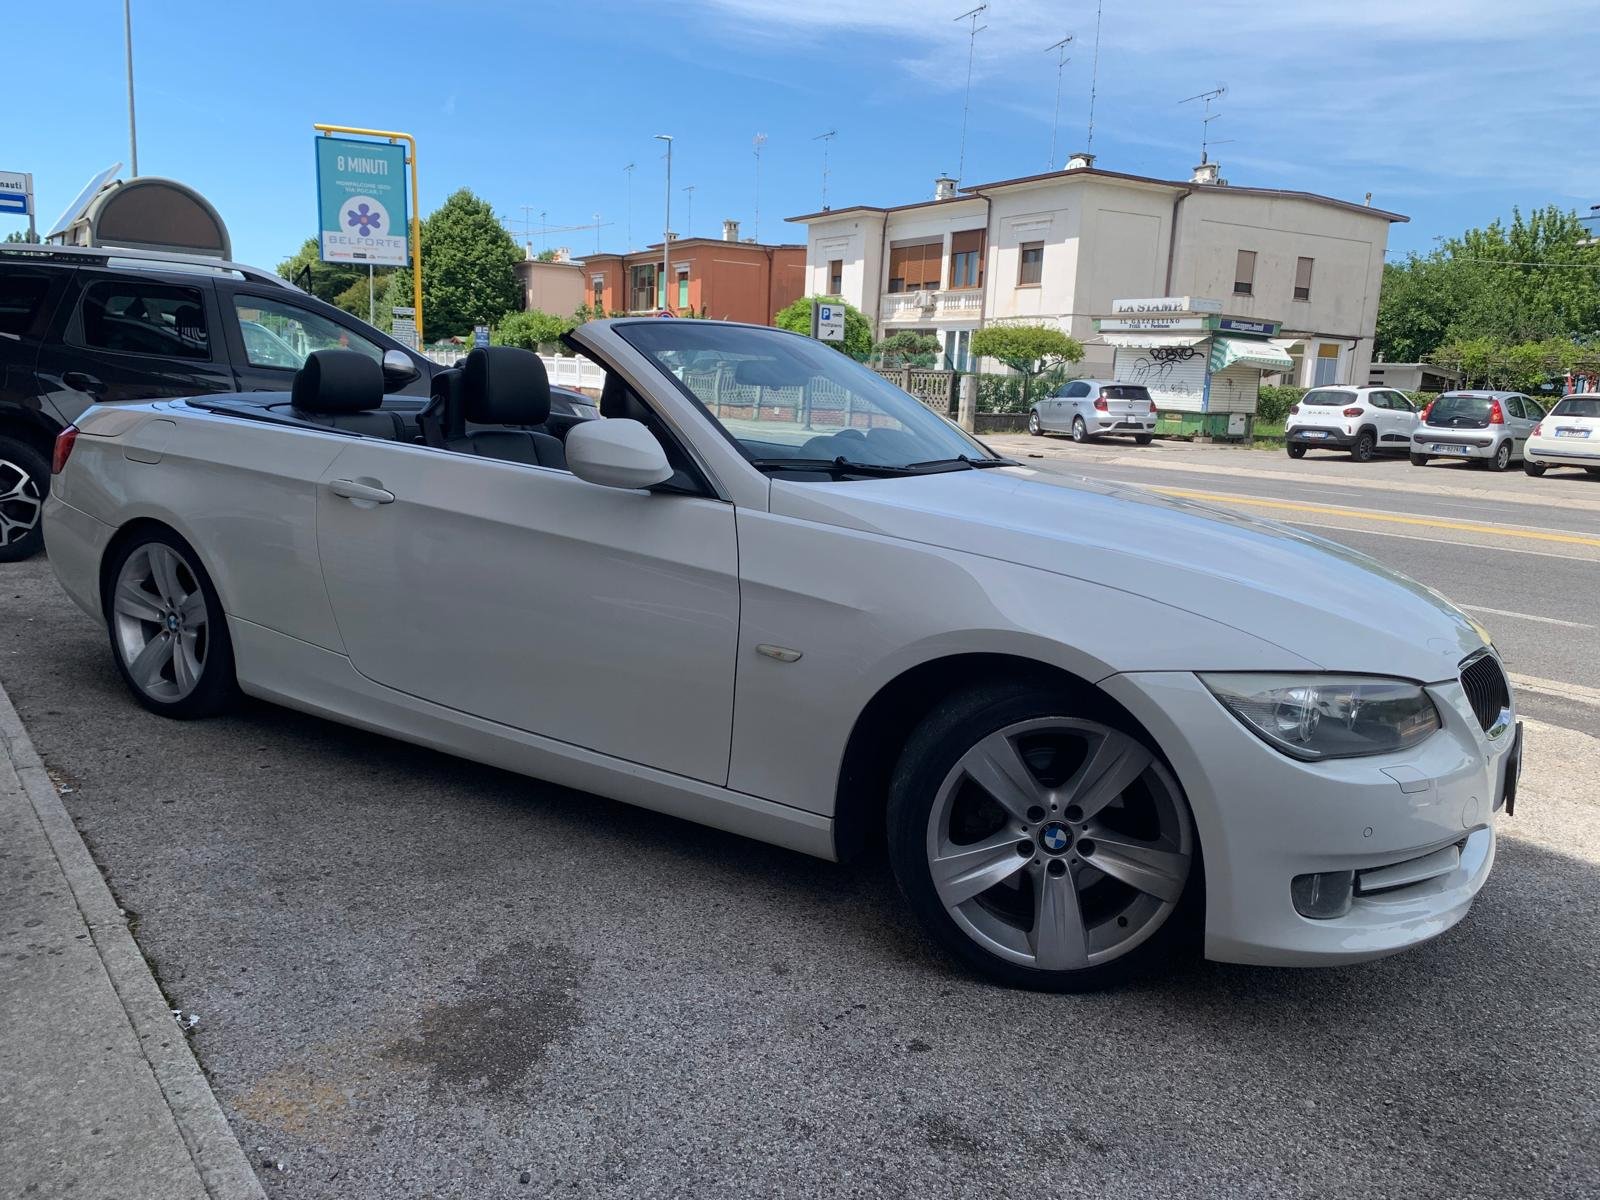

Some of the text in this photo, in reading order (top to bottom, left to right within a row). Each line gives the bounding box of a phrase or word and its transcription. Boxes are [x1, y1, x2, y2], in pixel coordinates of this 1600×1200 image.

[337, 155, 388, 175] 8 MINUTI
[329, 235, 401, 248] BELFORTE
